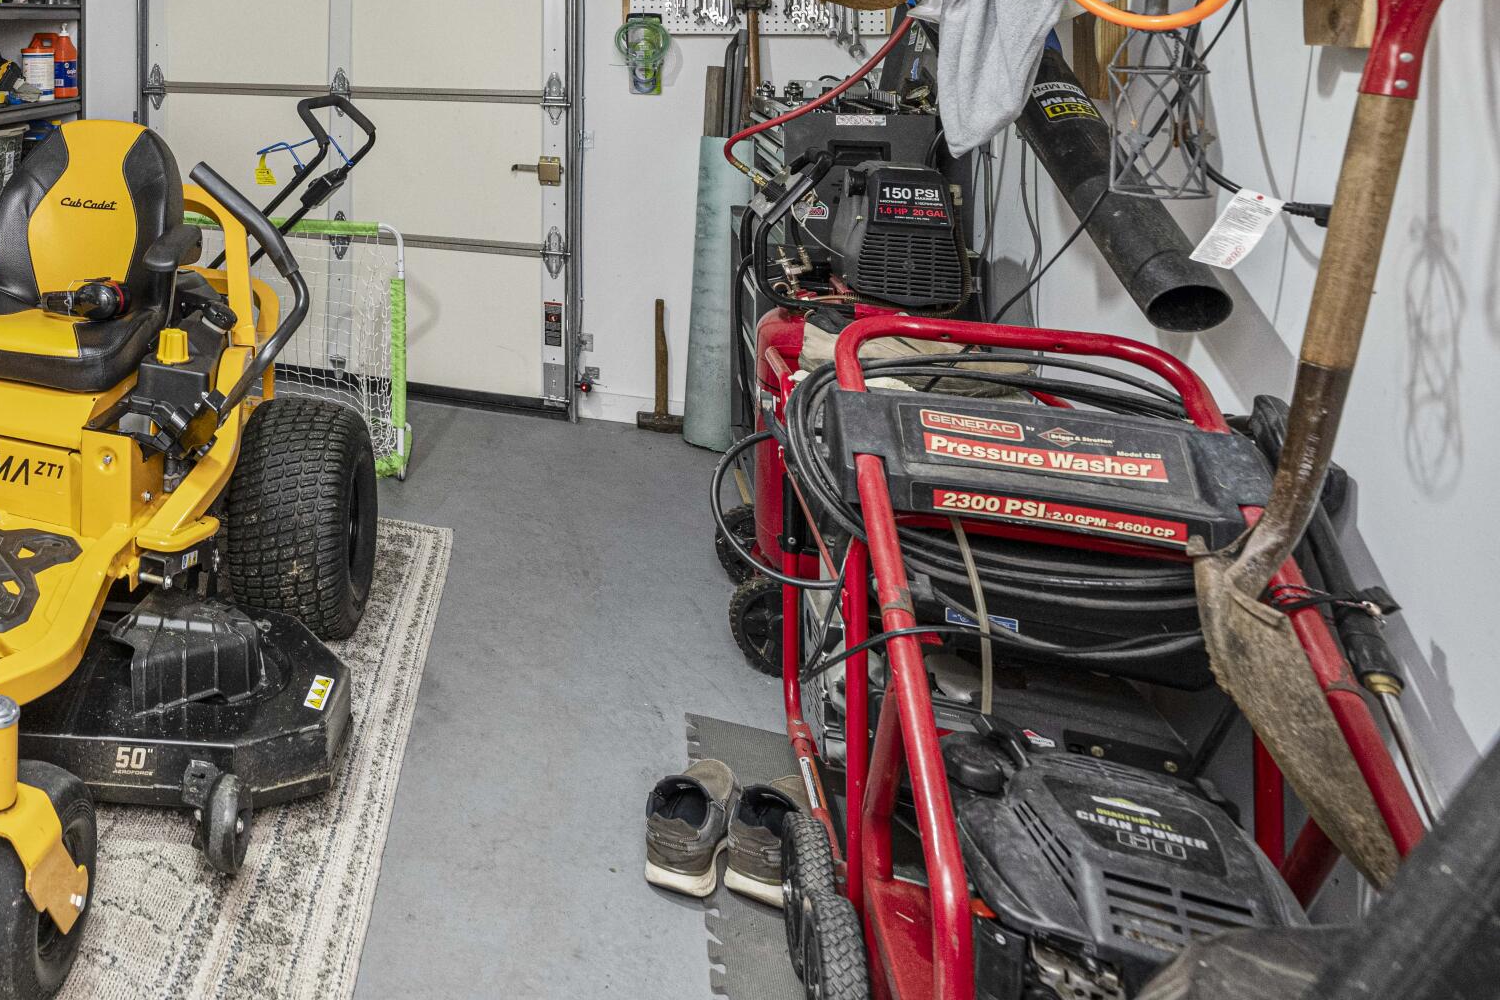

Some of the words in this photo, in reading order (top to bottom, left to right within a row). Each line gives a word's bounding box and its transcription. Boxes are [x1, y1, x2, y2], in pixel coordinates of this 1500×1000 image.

[882, 186, 912, 200] 150
[914, 188, 939, 199] PSI
[60, 197, 82, 208] Cub
[82, 199, 117, 211] Cadet
[894, 207, 908, 215] HP
[912, 209, 924, 217] 20
[925, 210, 947, 218] GAL
[928, 413, 1016, 434] GENERAC
[1050, 433, 1074, 442] Briggs
[1082, 436, 1114, 444] Stratton
[930, 435, 1045, 467] Pressure
[1047, 450, 1152, 477] Washer
[1116, 450, 1142, 459] Model
[34, 460, 65, 479] ZT1
[942, 493, 1000, 513] 2300
[1004, 498, 1046, 518] PSI
[1052, 511, 1074, 522] 2.0
[1074, 514, 1108, 528] GPM
[1114, 520, 1151, 535] 4600
[1152, 526, 1176, 539] CP
[115, 747, 154, 769] 50"
[112, 768, 155, 777] AEROFORCE
[1096, 807, 1151, 826] QUANTUM
[1075, 809, 1133, 832] CLEAN
[1139, 824, 1209, 850] POWER
